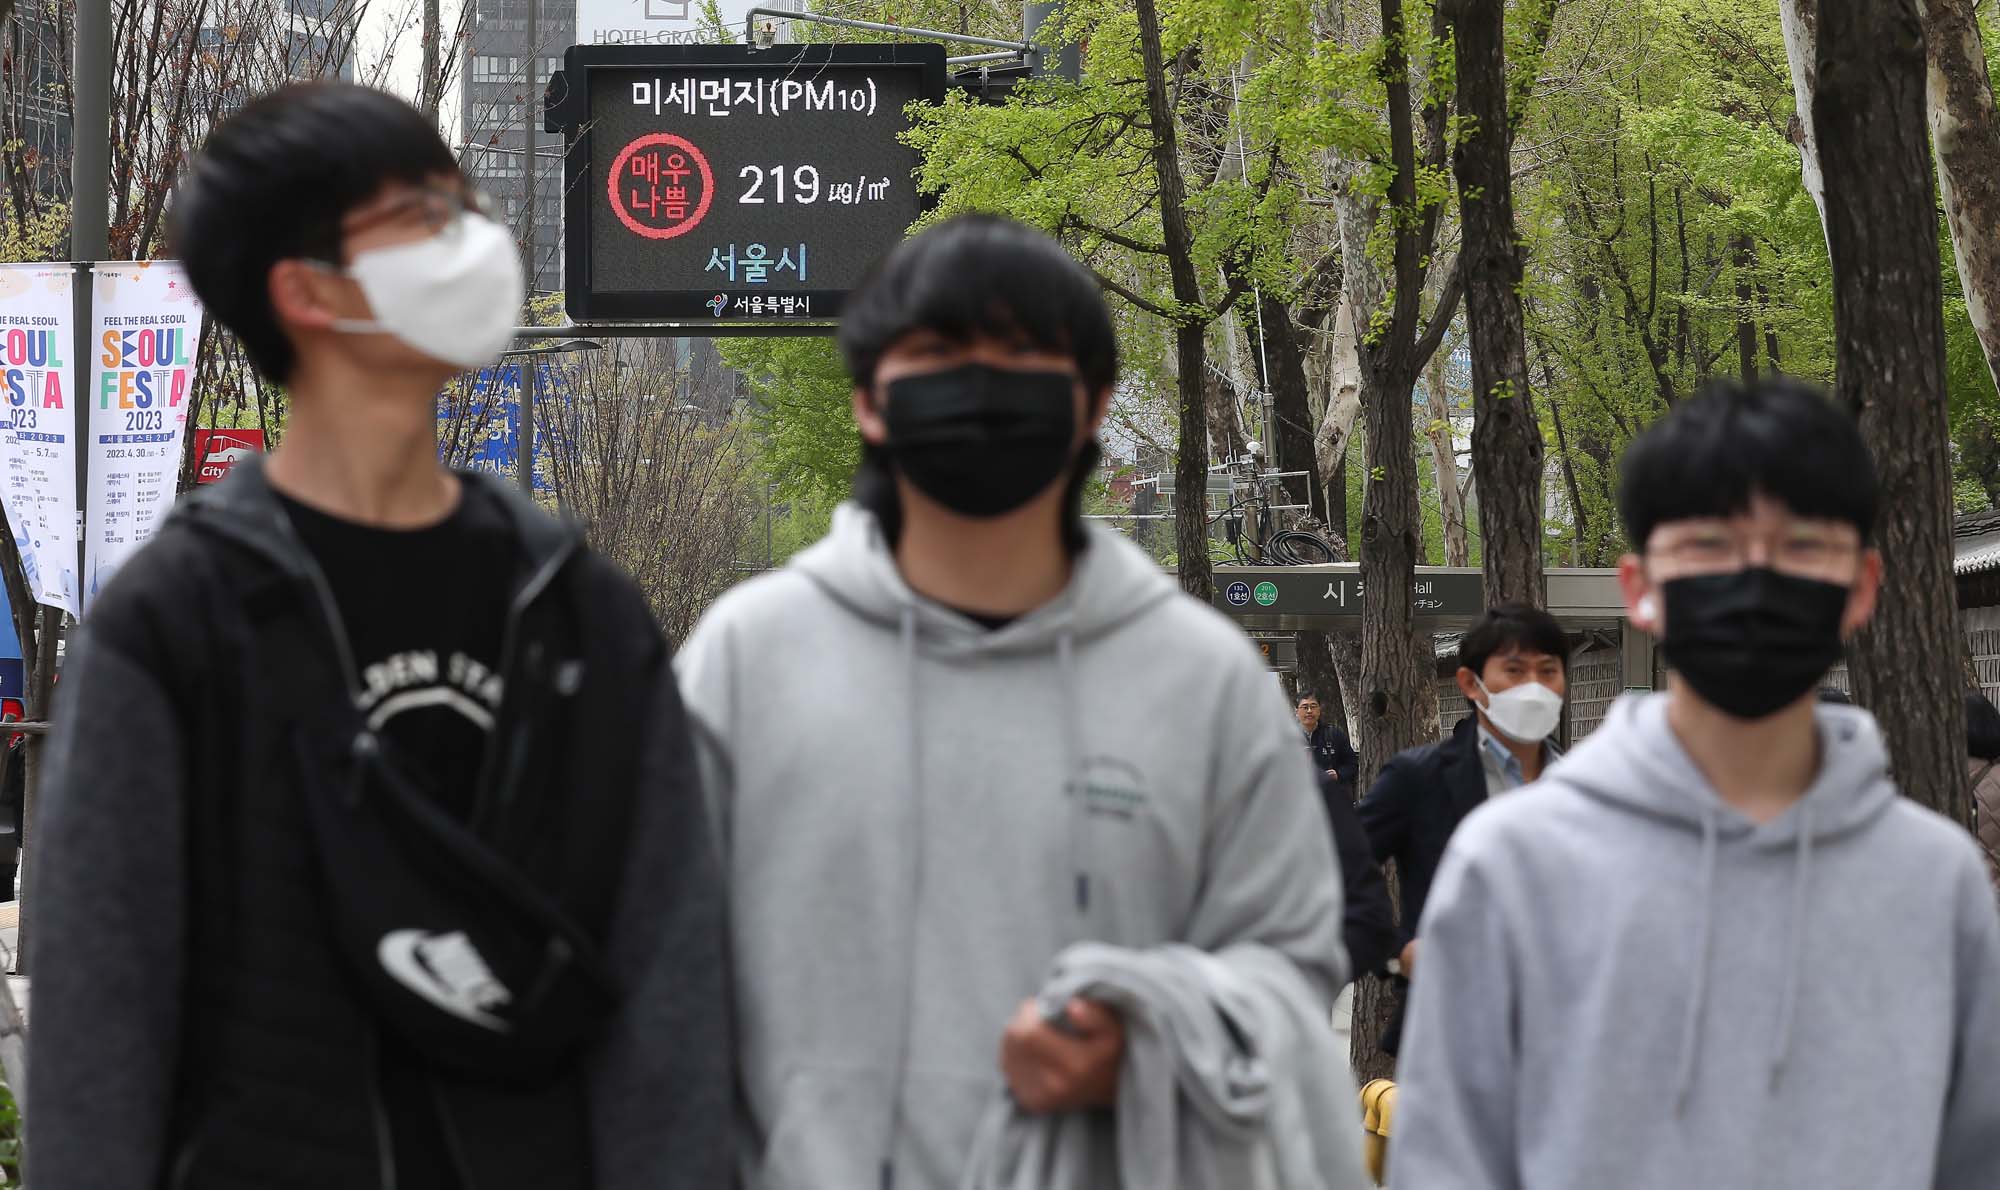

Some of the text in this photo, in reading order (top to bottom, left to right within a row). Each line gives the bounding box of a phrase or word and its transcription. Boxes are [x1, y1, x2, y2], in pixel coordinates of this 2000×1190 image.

[594, 29, 652, 44] HOTEL
[632, 78, 876, 116] 미세먼지(PM10)
[632, 152, 690, 184] 매우
[739, 165, 819, 204] 219
[632, 185, 690, 218] 나쁨
[705, 243, 805, 283] 서울시
[734, 296, 809, 313] 서울특별시
[9, 316, 30, 325] REAL
[31, 317, 59, 326] SEOUL
[104, 315, 186, 326] FEEL THE REAL SEOUL
[102, 328, 189, 368] SEOUL
[100, 369, 186, 410] FESTA
[126, 410, 162, 431] 2023
[31, 433, 57, 442] 2023
[201, 466, 225, 479] City
[1229, 592, 1248, 601] 1호선
[1256, 592, 1275, 601] 2호선
[1414, 599, 1443, 609] チョン
